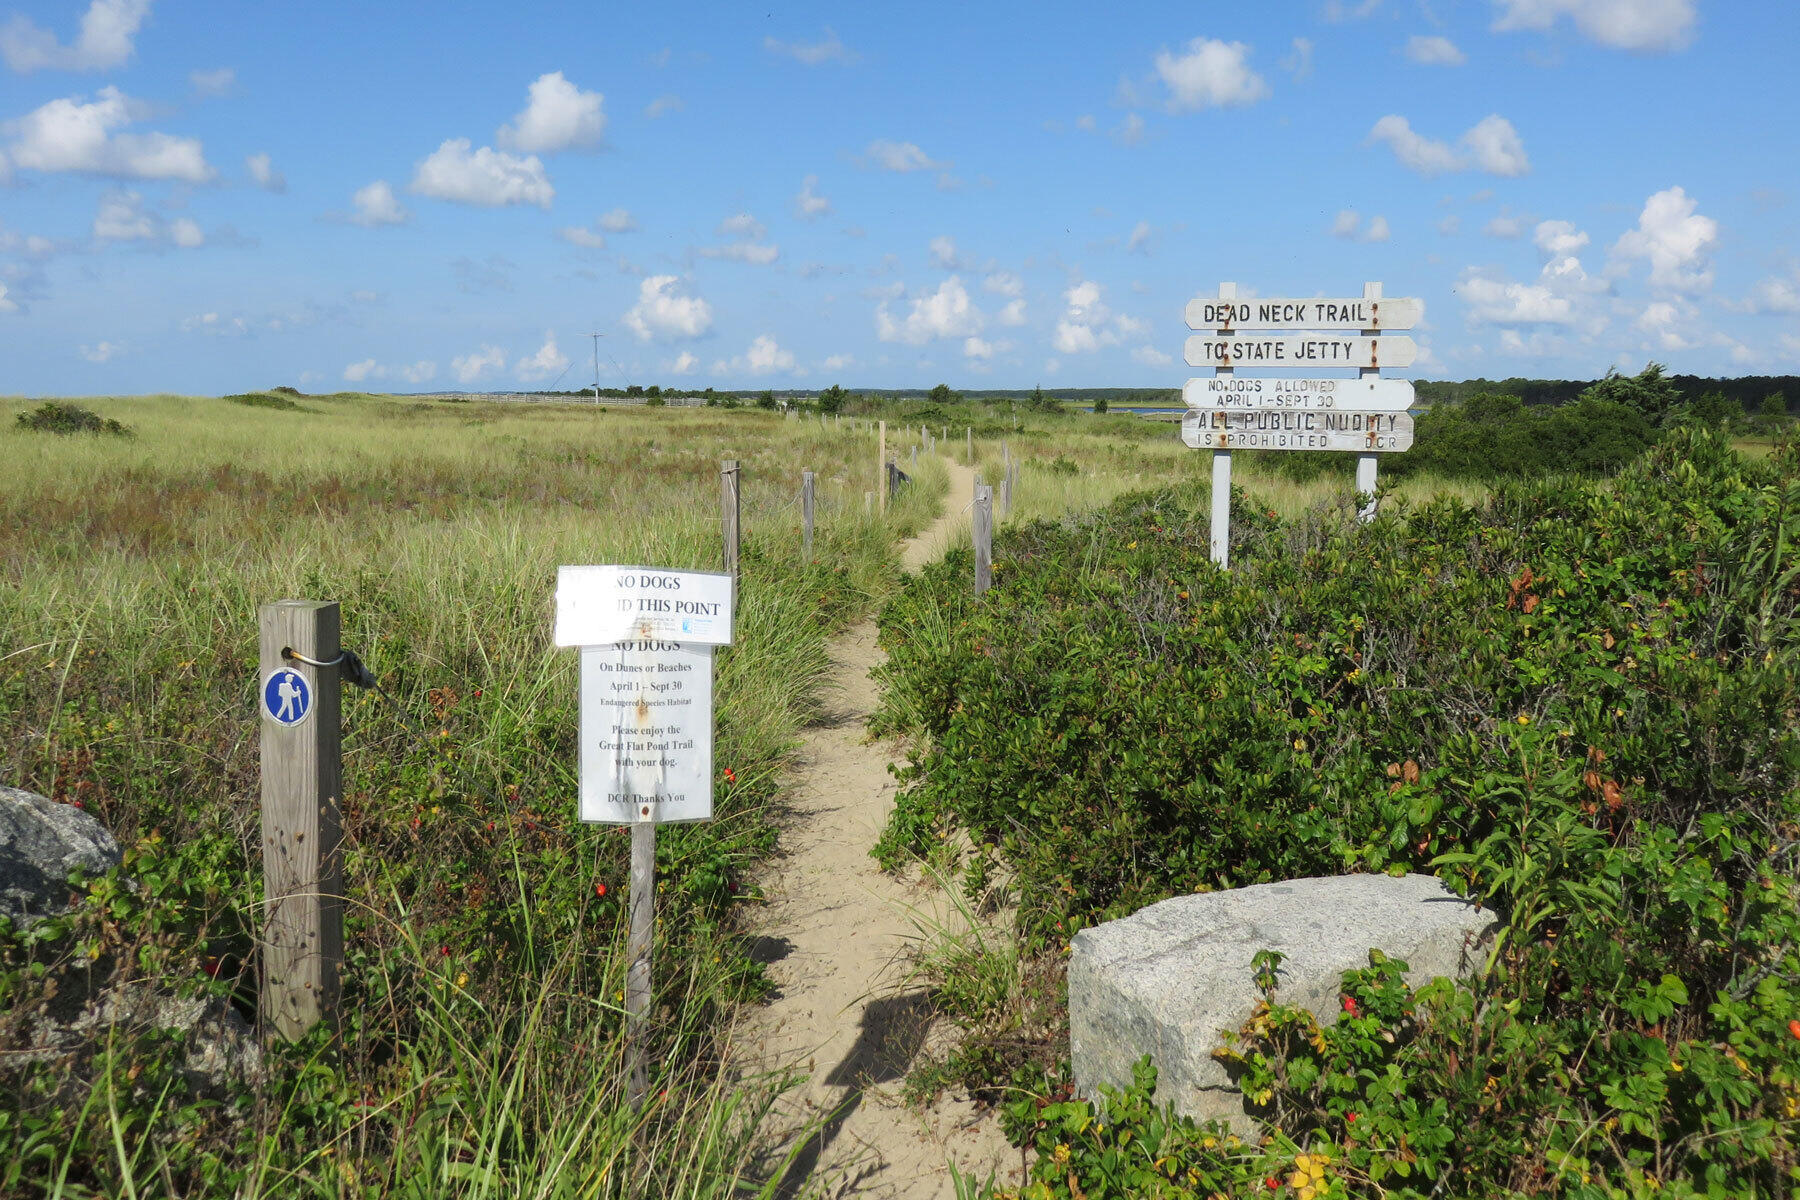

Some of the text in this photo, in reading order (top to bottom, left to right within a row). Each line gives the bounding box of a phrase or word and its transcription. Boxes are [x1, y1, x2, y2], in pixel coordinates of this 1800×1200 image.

[1204, 303, 1367, 322] DEAD NECK TRAIL
[1204, 342, 1352, 359] TO STATE JETTY
[1209, 381, 1334, 392] NO DOGS ALLOWED
[1217, 395, 1252, 406] APRIL
[1317, 396, 1334, 407] 30
[1198, 413, 1396, 431] ALL PUBLIC NUDITY
[1198, 435, 1396, 448] IS PROHIBITED DCR
[617, 576, 680, 590] NO DOGS
[638, 599, 670, 612] THIS
[675, 601, 720, 616] POINT
[612, 640, 680, 651] NO DOGS
[600, 662, 613, 672] On
[616, 663, 642, 672] Dunes
[658, 663, 692, 672] Beaches
[610, 682, 632, 692] April
[636, 682, 640, 691] 1
[651, 682, 670, 692] Sept
[672, 682, 682, 690] 30
[612, 725, 680, 737] Please enjoy the
[599, 740, 693, 750] Great Flat Pond Trail
[616, 757, 677, 768] with your dog.
[608, 793, 685, 803] DCR Thanks You
